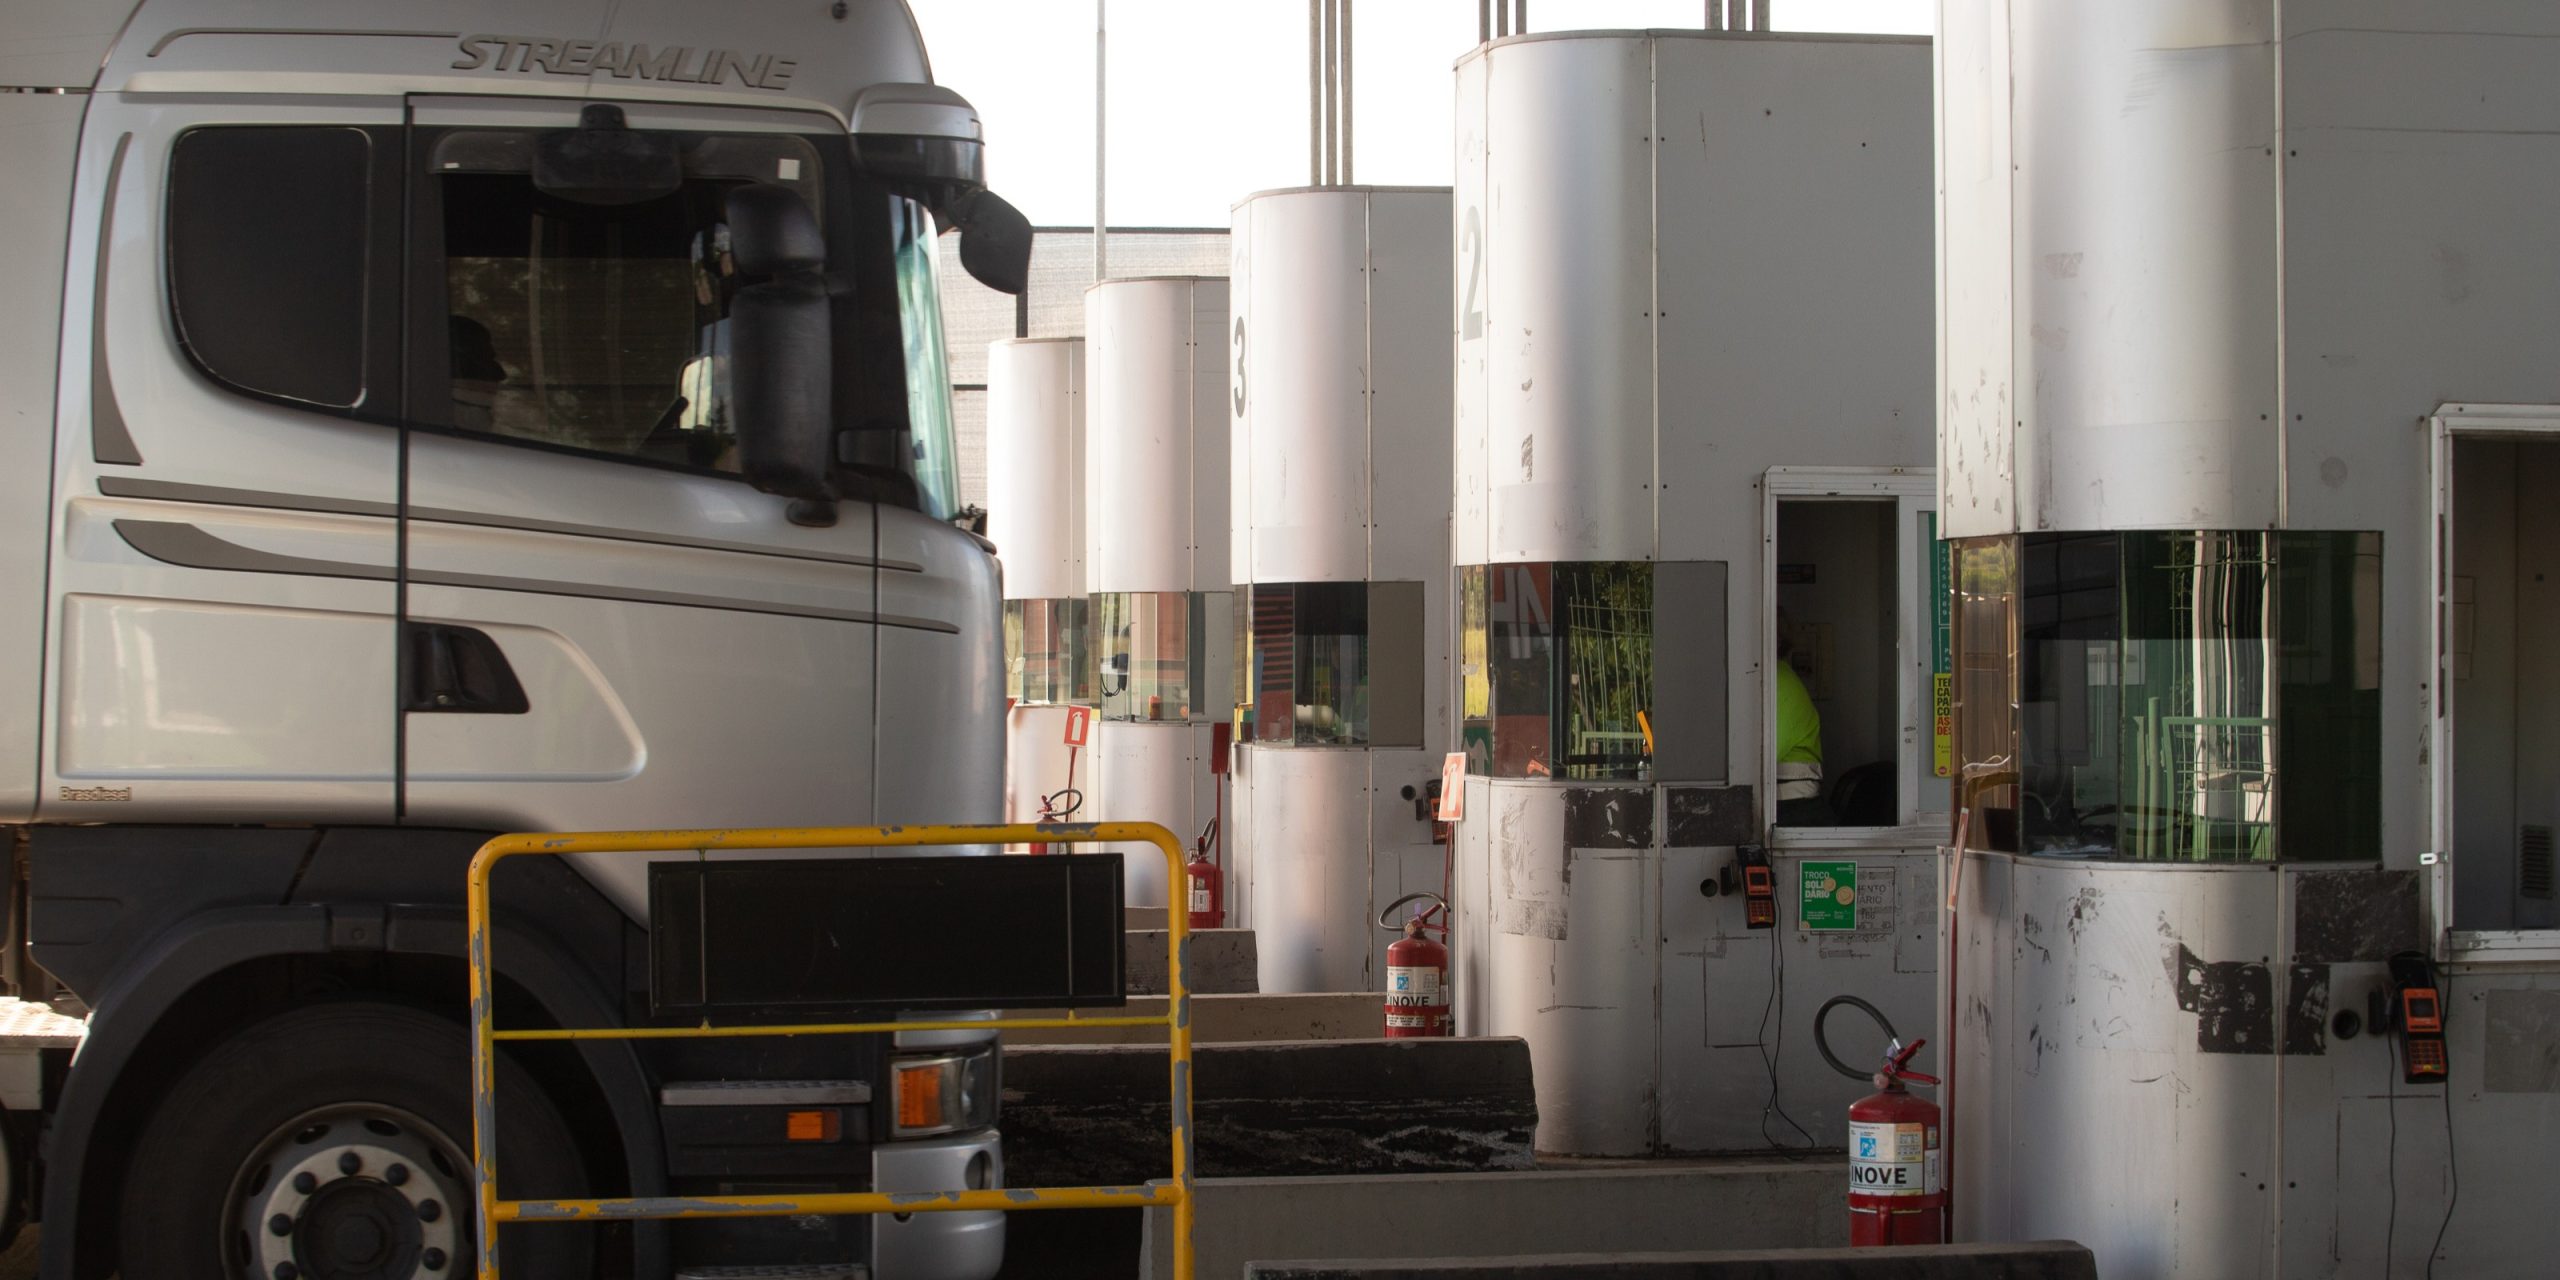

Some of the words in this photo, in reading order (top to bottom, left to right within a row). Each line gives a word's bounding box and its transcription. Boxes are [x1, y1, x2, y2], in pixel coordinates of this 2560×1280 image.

[451, 33, 797, 90] STREAMLINE
[1462, 205, 1482, 341] 2
[1234, 316, 1246, 418] 3
[1937, 698, 1951, 706] PA
[59, 786, 132, 801] Brasdiesel
[1804, 871, 1830, 879] TROCO
[1389, 995, 1430, 1006] INOVE
[1852, 1165, 1906, 1184] INOVE
